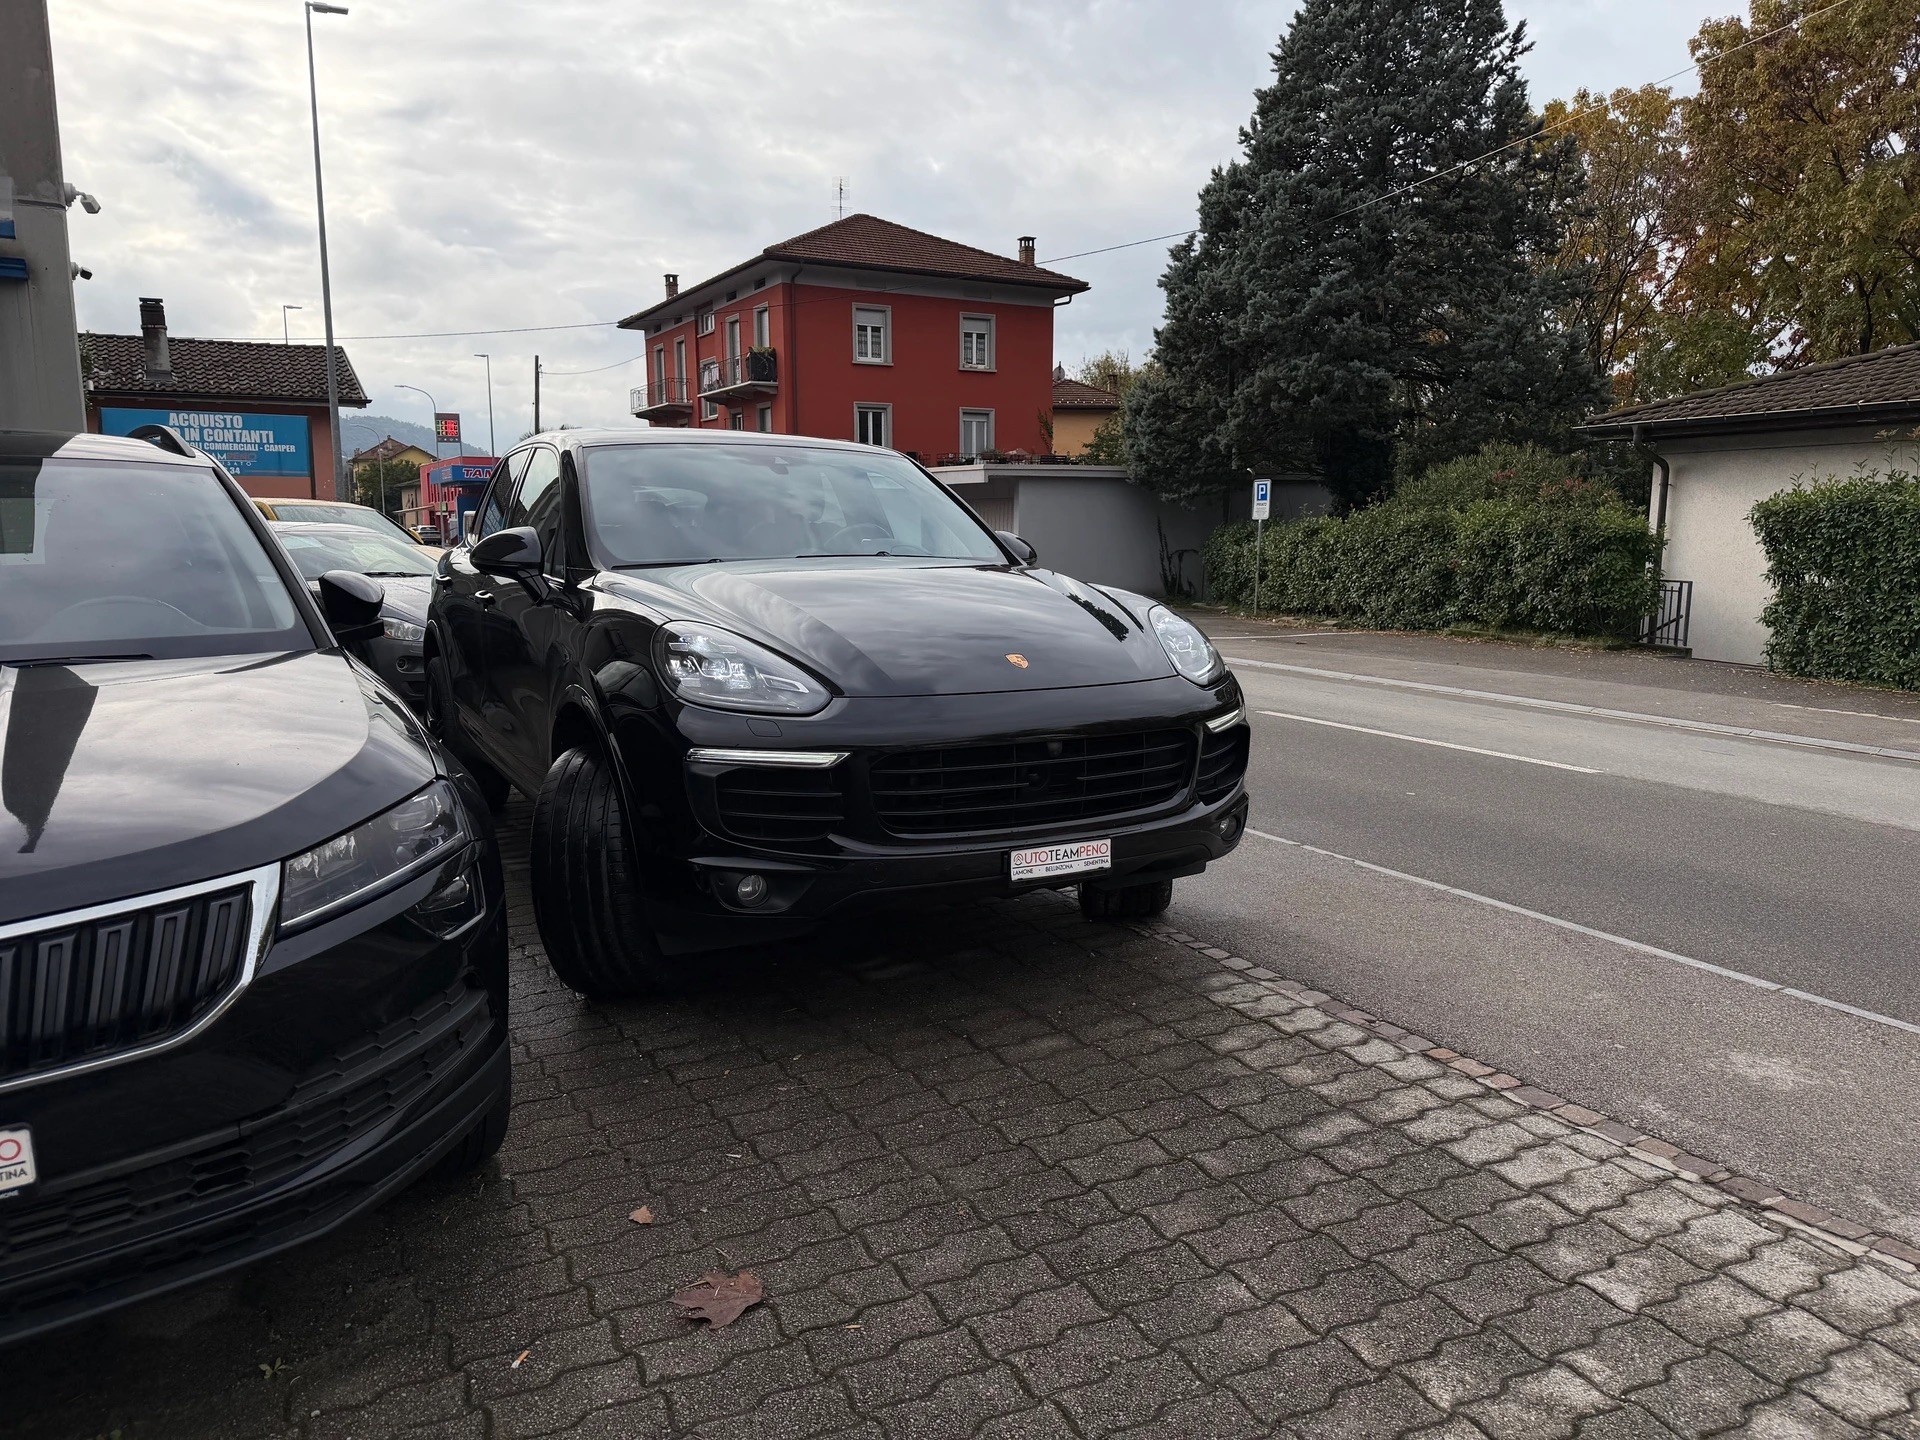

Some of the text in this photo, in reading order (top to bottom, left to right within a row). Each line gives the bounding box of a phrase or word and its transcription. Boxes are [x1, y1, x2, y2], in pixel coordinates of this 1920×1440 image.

[169, 412, 243, 429] ACQUISTO
[185, 427, 200, 441] IN
[203, 428, 274, 443] CONTANTI
[204, 442, 258, 451] COMMERCIALI
[264, 444, 296, 453] CAMPER
[1258, 485, 1266, 500] P
[1012, 868, 1034, 876] LAMONE
[1083, 858, 1110, 867] SEMENTINA
